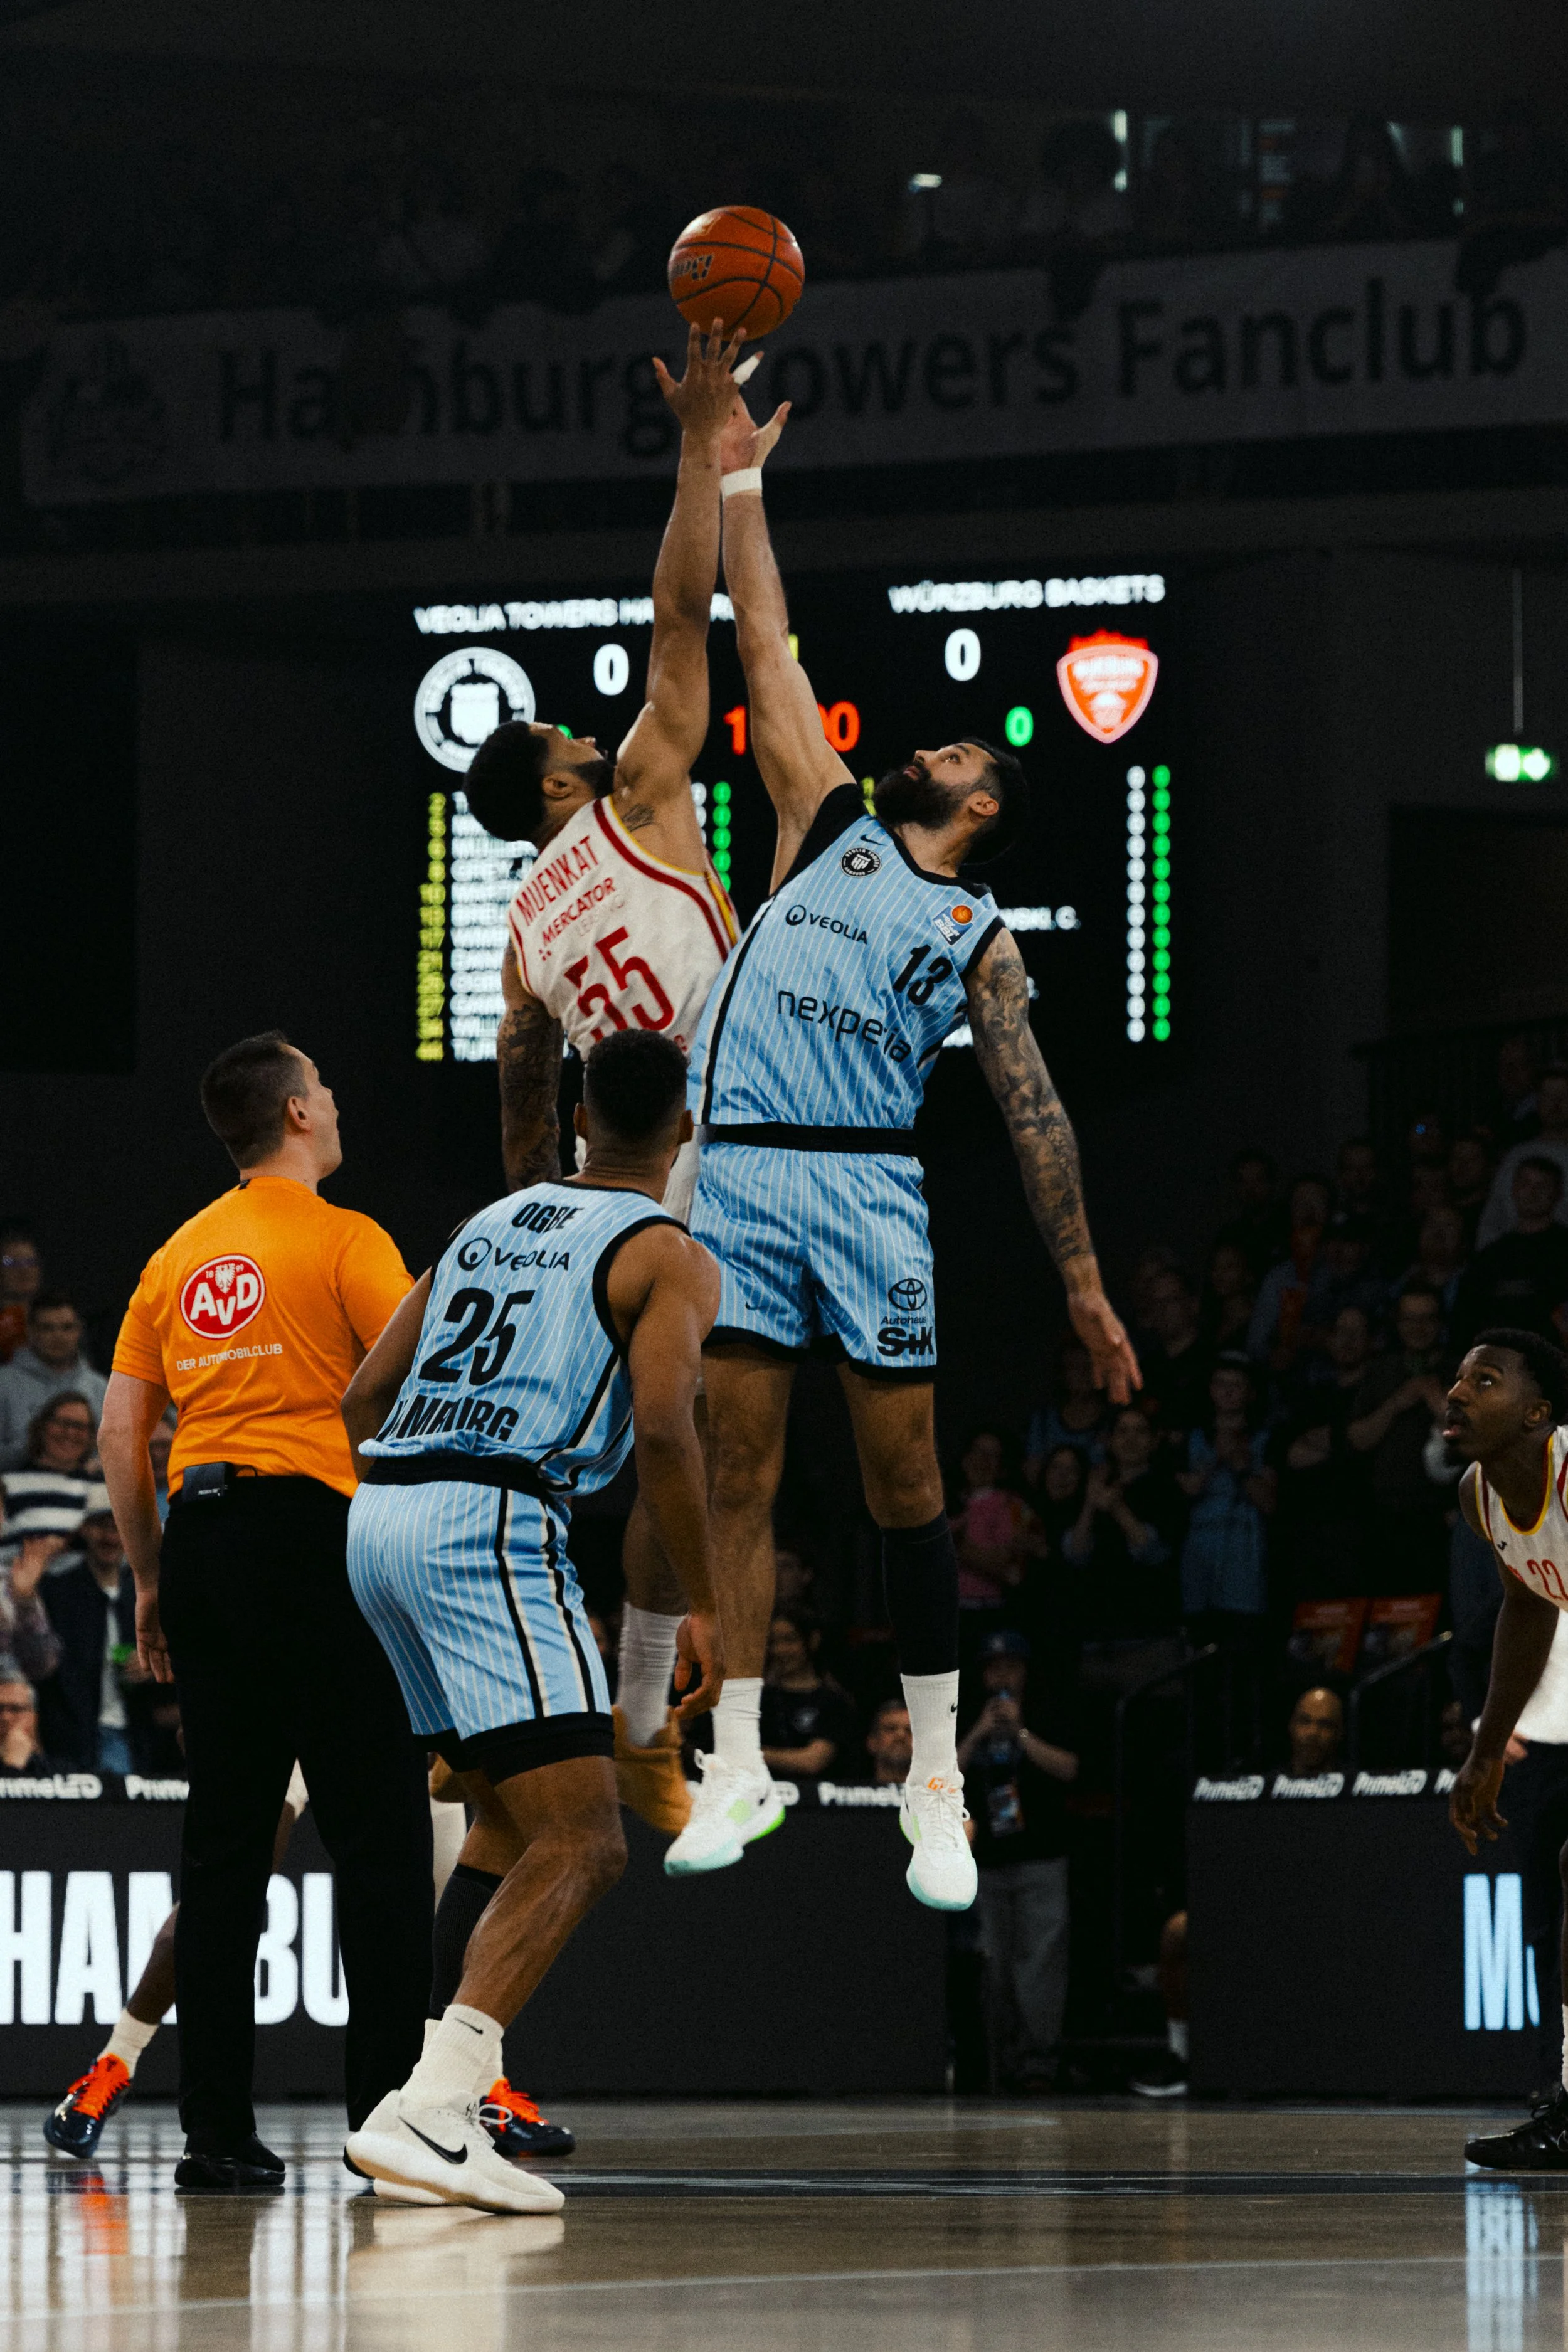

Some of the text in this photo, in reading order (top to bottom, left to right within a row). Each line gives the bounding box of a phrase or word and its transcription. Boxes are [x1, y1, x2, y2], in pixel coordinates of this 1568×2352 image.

[769, 325, 1081, 423] owers
[1115, 275, 1525, 401] Fanclub
[593, 644, 629, 696] 0
[945, 628, 981, 681] 0
[1005, 706, 1034, 747] 0
[516, 835, 599, 927] MUENKAT
[541, 877, 616, 946] MERCATOR
[810, 913, 867, 945] VEOLIA
[564, 926, 674, 1042] 55
[892, 944, 953, 1006] 13
[778, 990, 912, 1064] nexpeia
[494, 1246, 570, 1271] VEOLIA
[417, 1287, 536, 1387] 25
[881, 1316, 927, 1325] Autohaus
[176, 1343, 283, 1371] DER AUTOMOBILCLUB
[1527, 1559, 1568, 1601] 22
[817, 1781, 904, 1806] PrimeL
